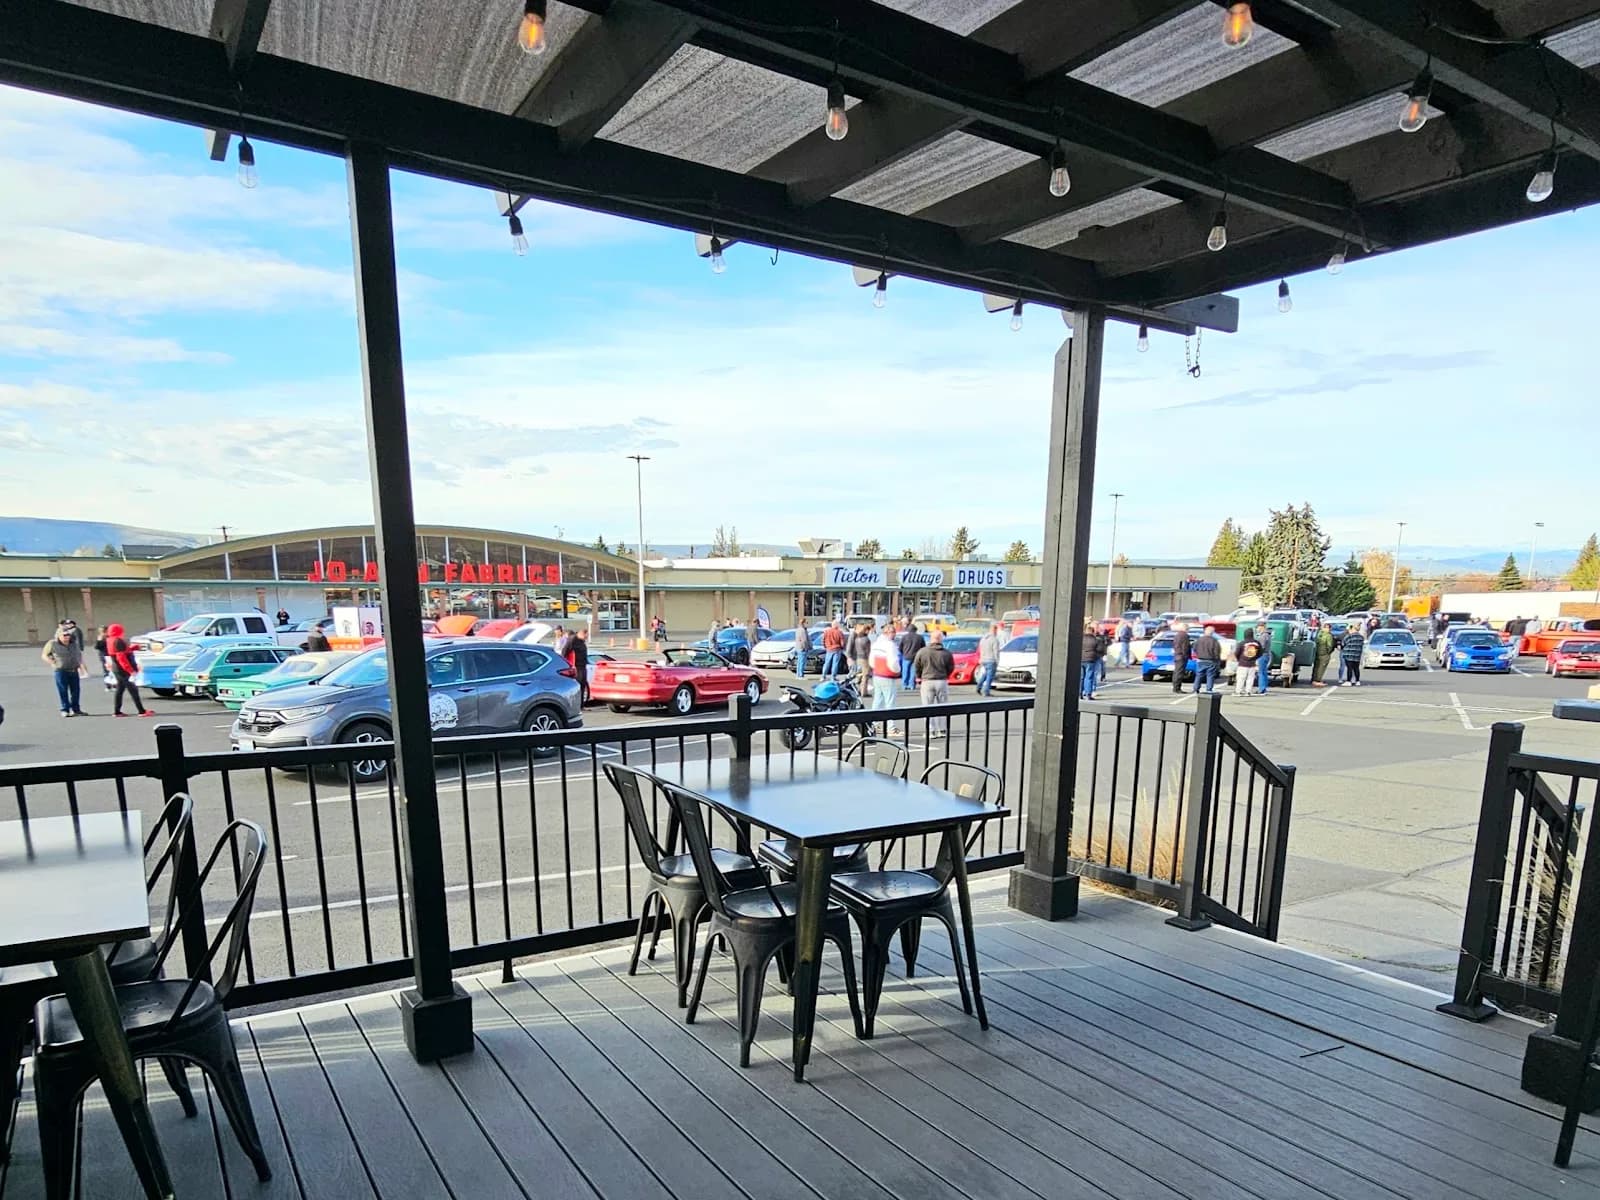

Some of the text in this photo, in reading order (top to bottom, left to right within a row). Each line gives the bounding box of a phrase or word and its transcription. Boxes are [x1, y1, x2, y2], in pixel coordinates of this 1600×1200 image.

[307, 560, 561, 585] JO-AN FABRICS
[832, 567, 1004, 586] Tieton Village DRUGS
